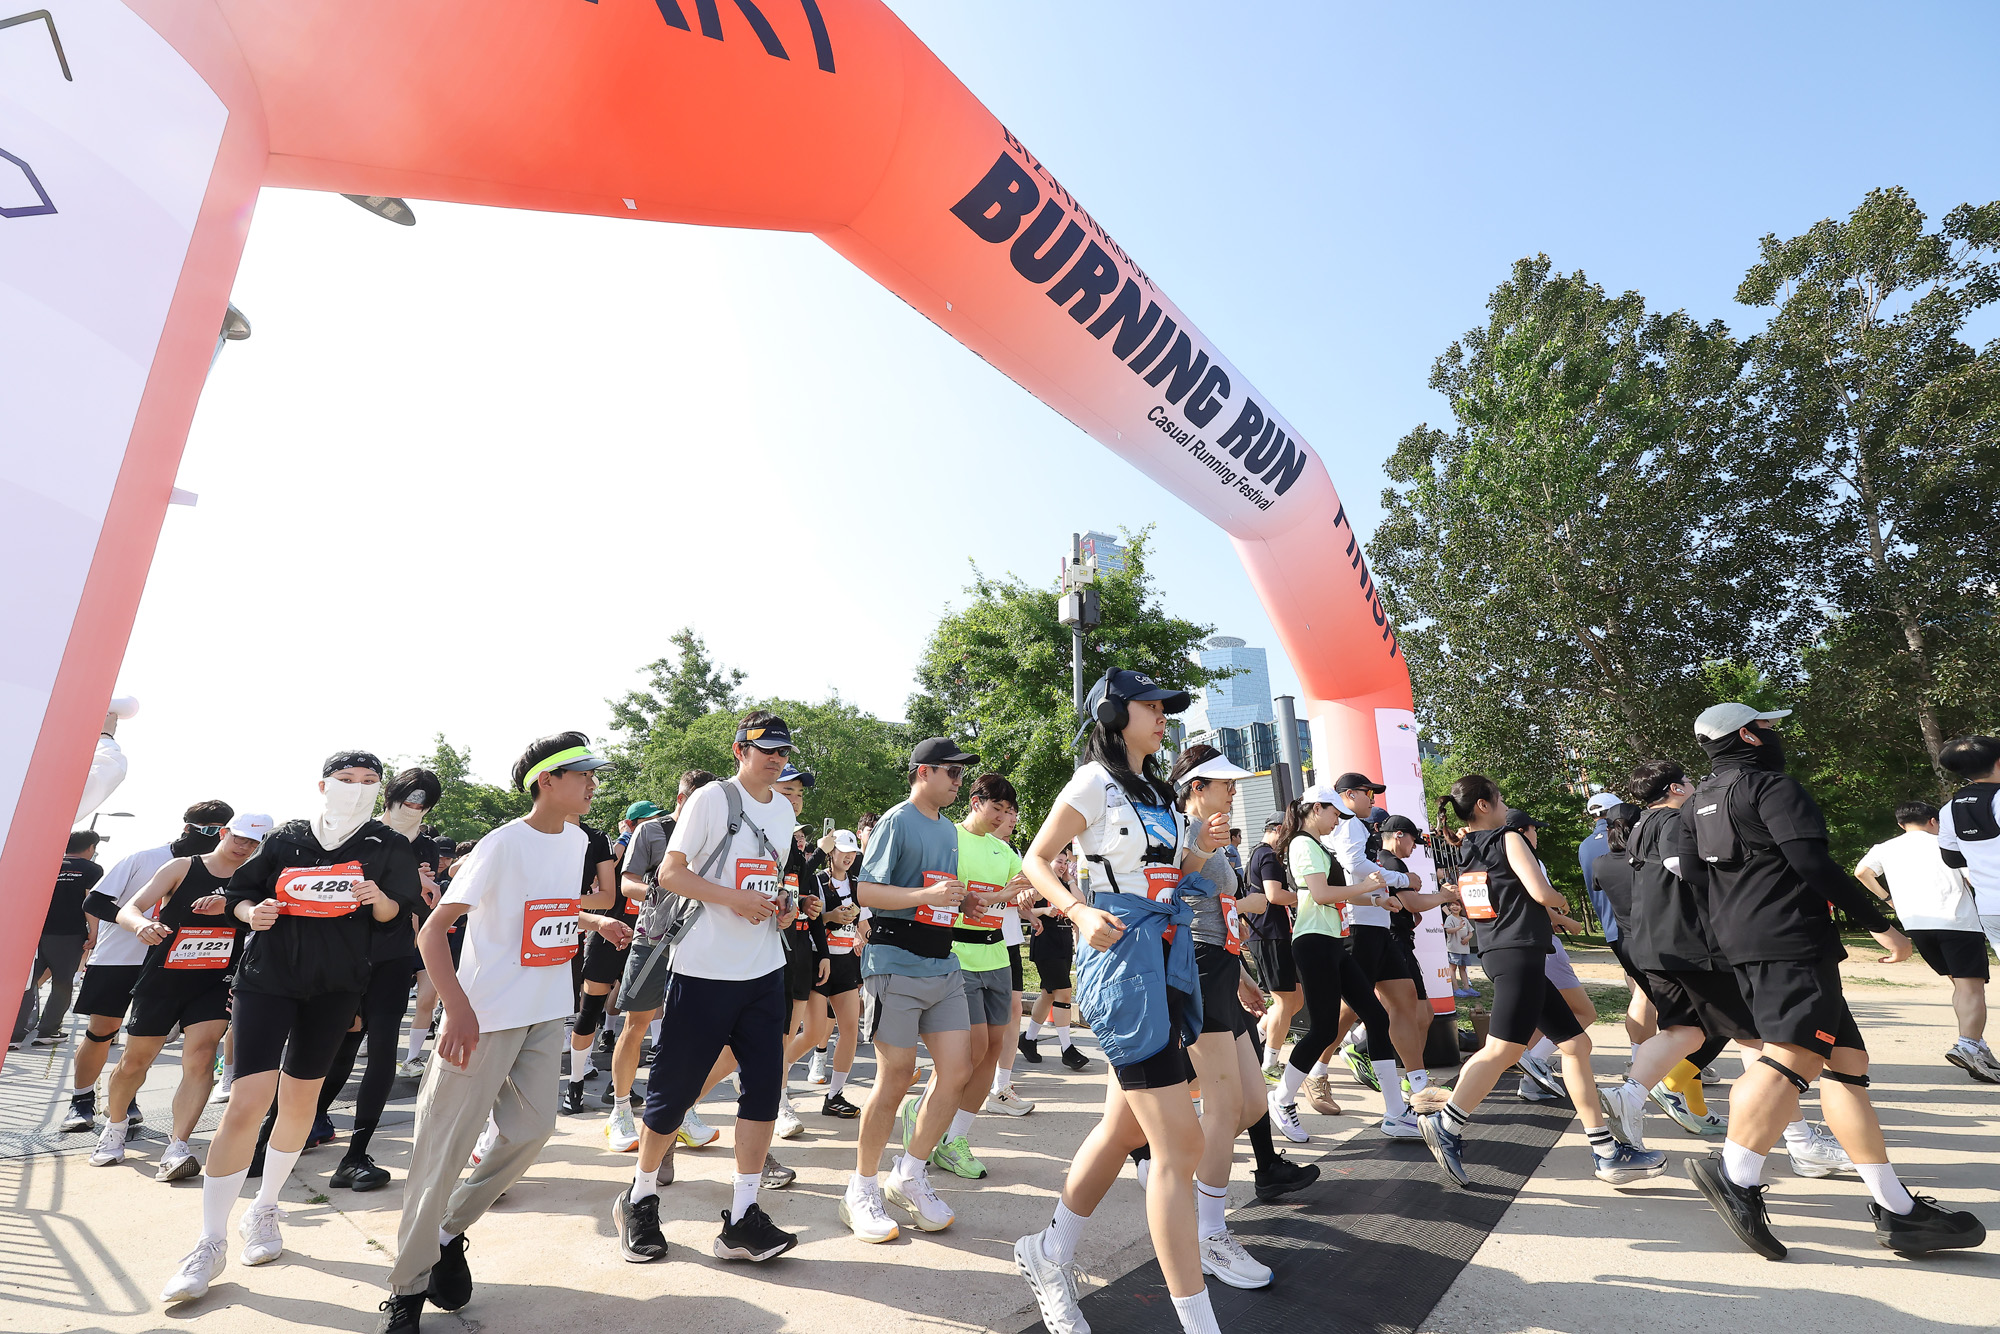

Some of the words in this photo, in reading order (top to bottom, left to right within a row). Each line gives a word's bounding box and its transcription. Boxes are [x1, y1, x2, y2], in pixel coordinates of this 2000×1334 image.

[949, 150, 1231, 431] BURNING
[1215, 396, 1307, 497] RUN
[1147, 405, 1196, 448] Casual
[1188, 439, 1238, 485] Running
[1233, 475, 1275, 512] Festival
[293, 884, 307, 892] W
[747, 881, 756, 890] M
[529, 903, 559, 911] BURNING
[539, 925, 552, 936] M
[196, 941, 230, 951] 1221
